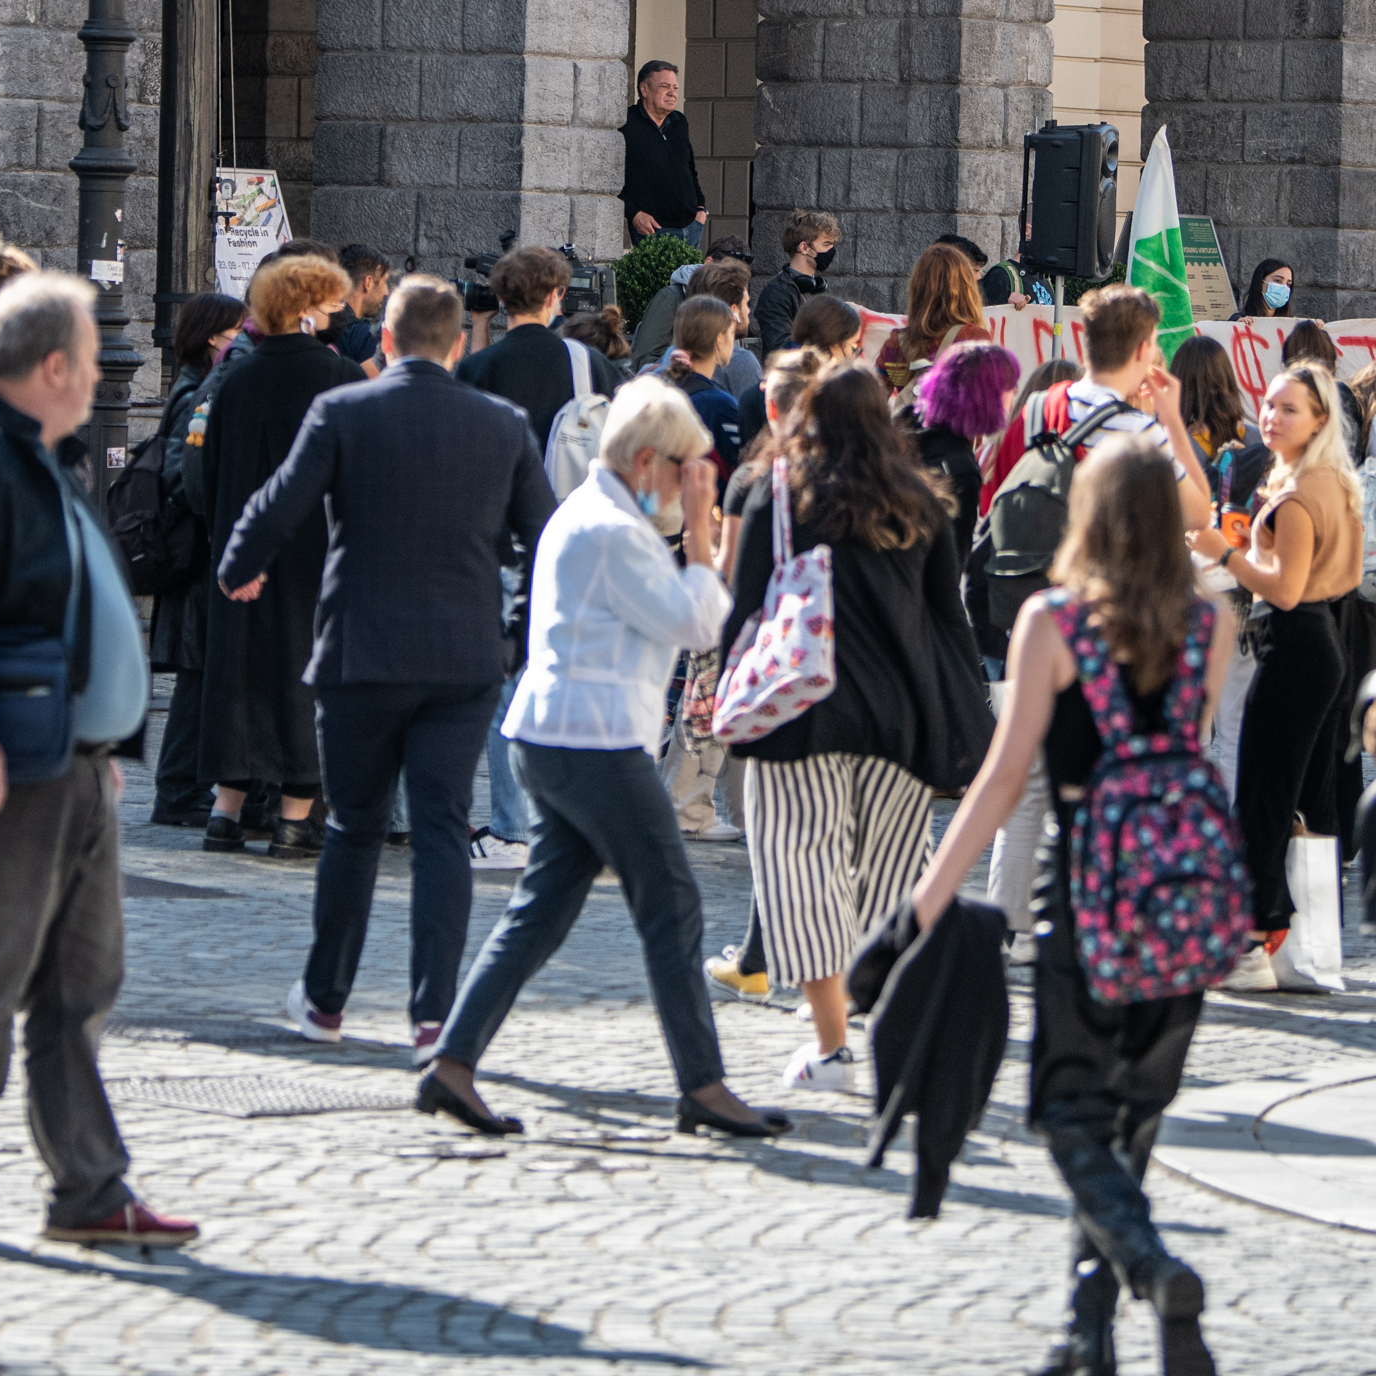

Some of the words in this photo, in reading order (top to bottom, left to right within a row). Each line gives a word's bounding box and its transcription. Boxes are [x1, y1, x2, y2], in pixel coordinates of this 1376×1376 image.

[231, 226, 259, 239] Recycle
[260, 228, 269, 237] in
[227, 238, 258, 248] Fashion
